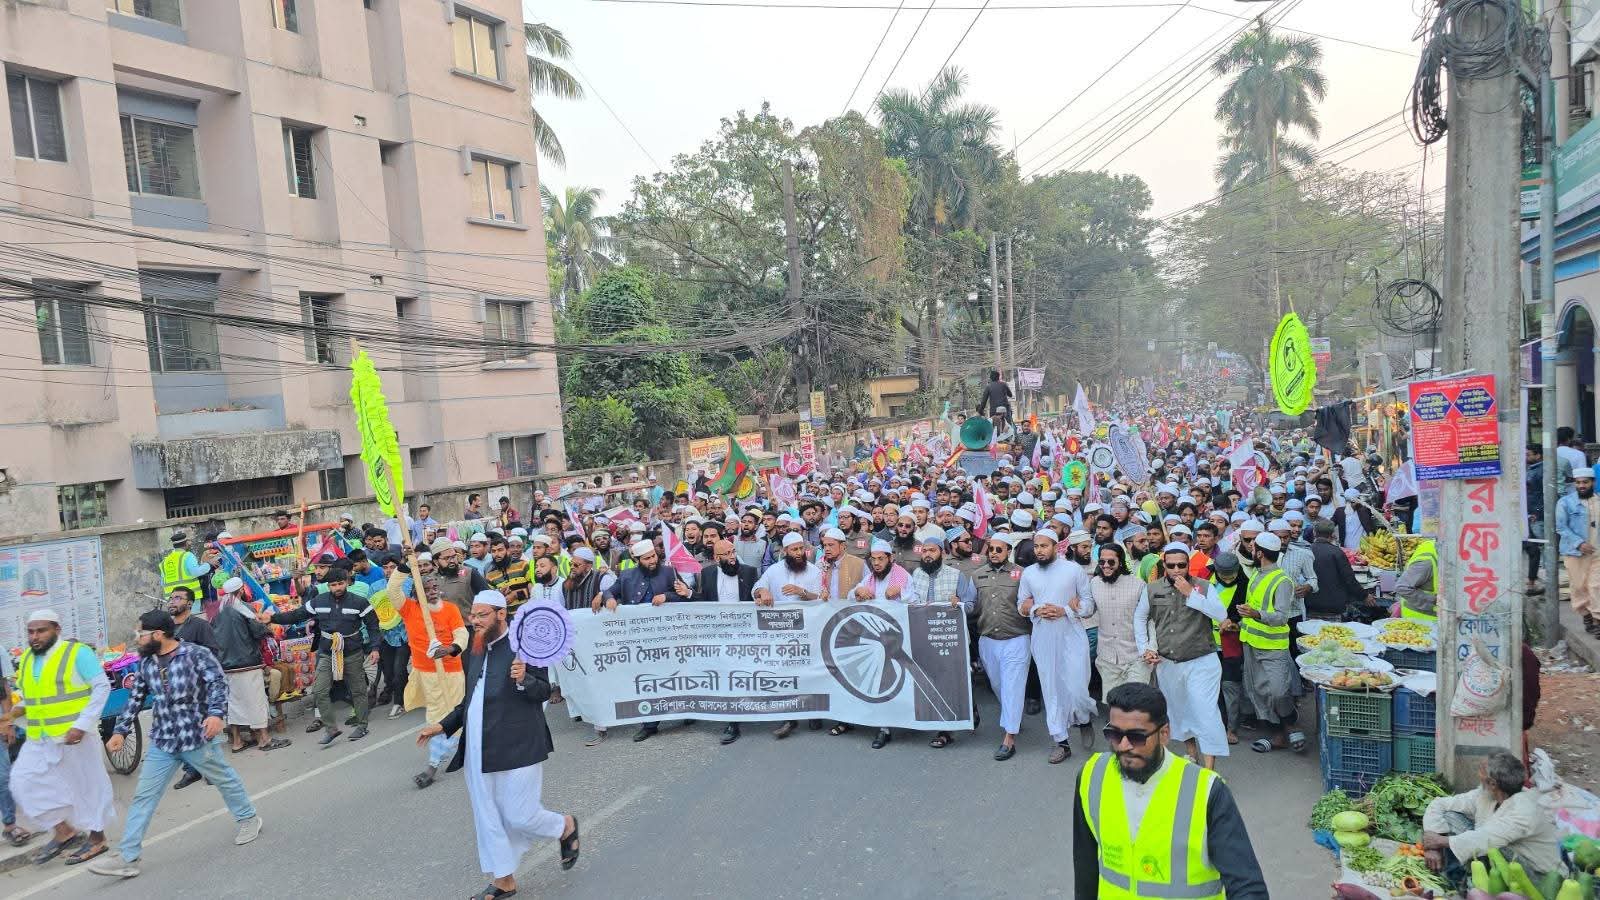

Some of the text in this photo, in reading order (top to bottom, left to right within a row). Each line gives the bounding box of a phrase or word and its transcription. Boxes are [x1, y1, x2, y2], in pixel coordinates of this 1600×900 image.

[664, 612, 691, 622] জাতীয়
[694, 613, 717, 621] সংসদ
[720, 611, 752, 620] নির্বাচনে
[761, 611, 780, 620] সংসদ
[1459, 615, 1500, 638] কোচিং
[593, 639, 811, 671] মুফতী সৈয়দ মুহাম্মাদ ফয়জুল করীম
[633, 669, 800, 695] নির্বাচনী মিছিল
[653, 698, 696, 713] বরিশাল-৫
[699, 699, 729, 711] আসনের
[731, 698, 768, 712] সর্বস্তরের
[770, 697, 798, 711] জনগণ
